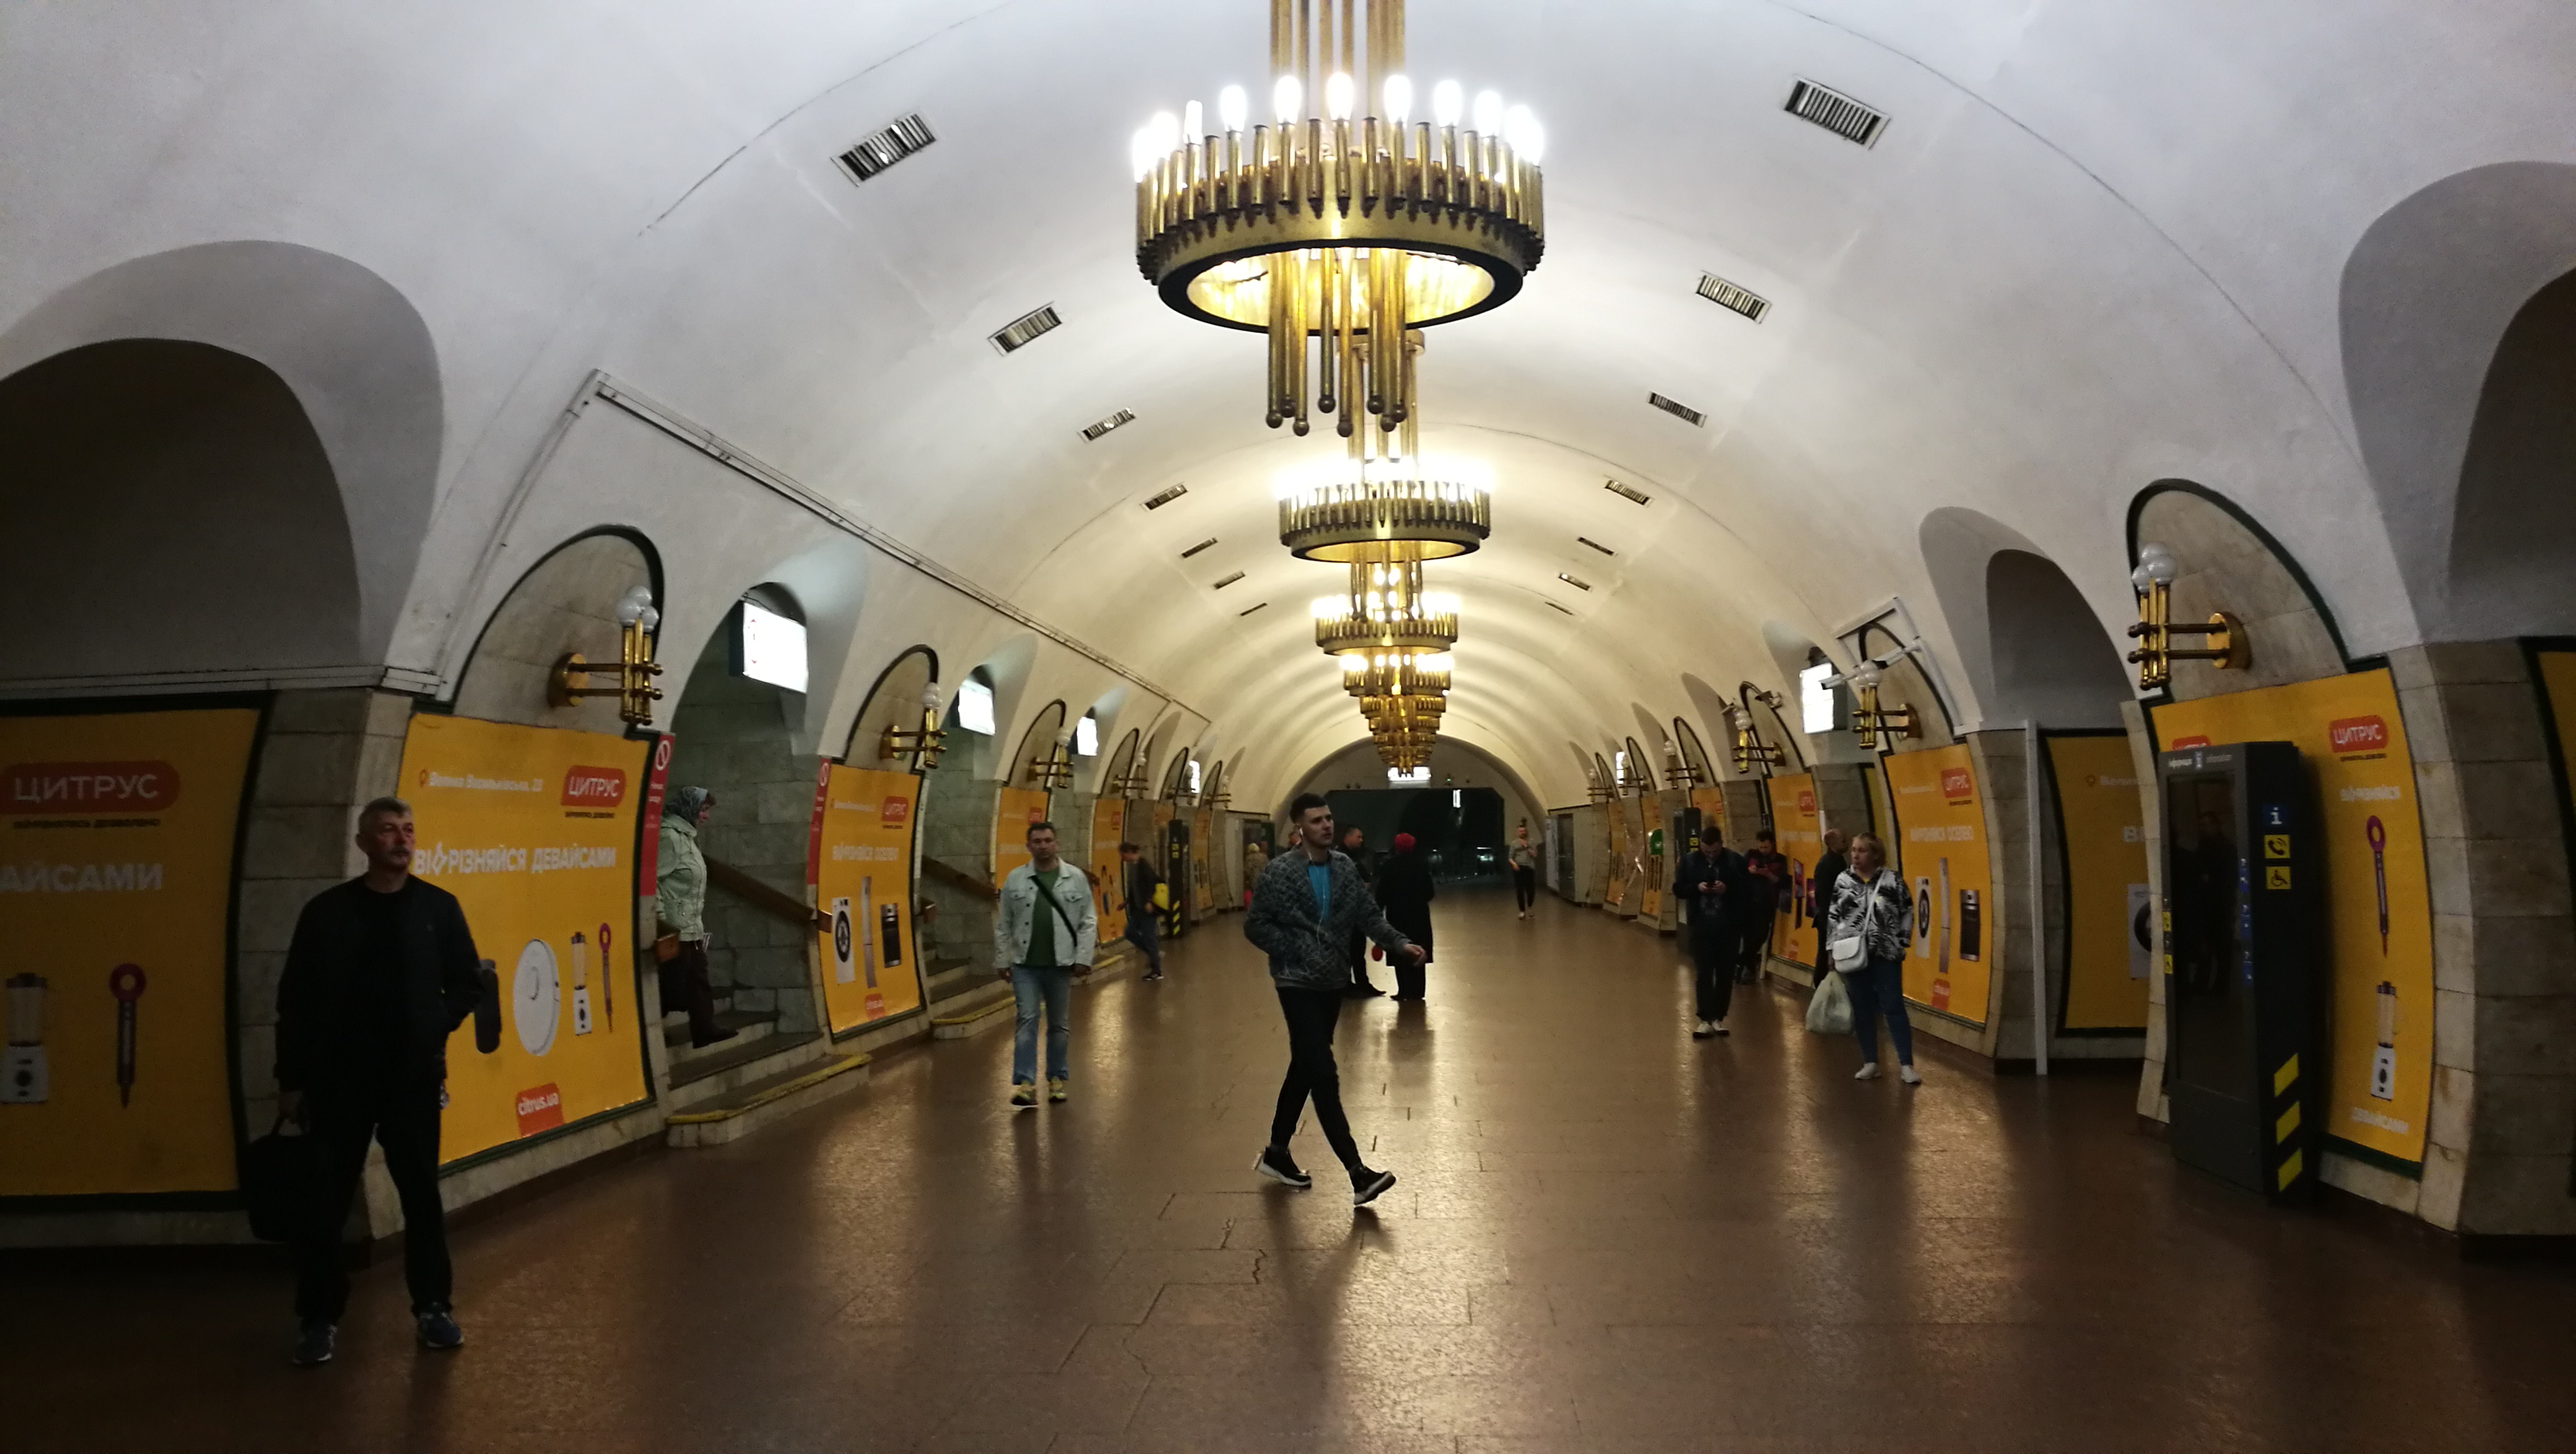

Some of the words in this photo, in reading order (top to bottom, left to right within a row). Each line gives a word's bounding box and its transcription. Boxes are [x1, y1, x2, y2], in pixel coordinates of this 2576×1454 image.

[2333, 724, 2383, 745] ЦИТРУС
[14, 774, 160, 803] ЦИТРУС
[567, 776, 620, 797] ЦИТРУС
[531, 843, 616, 874] ДЕВАЙСАМИ
